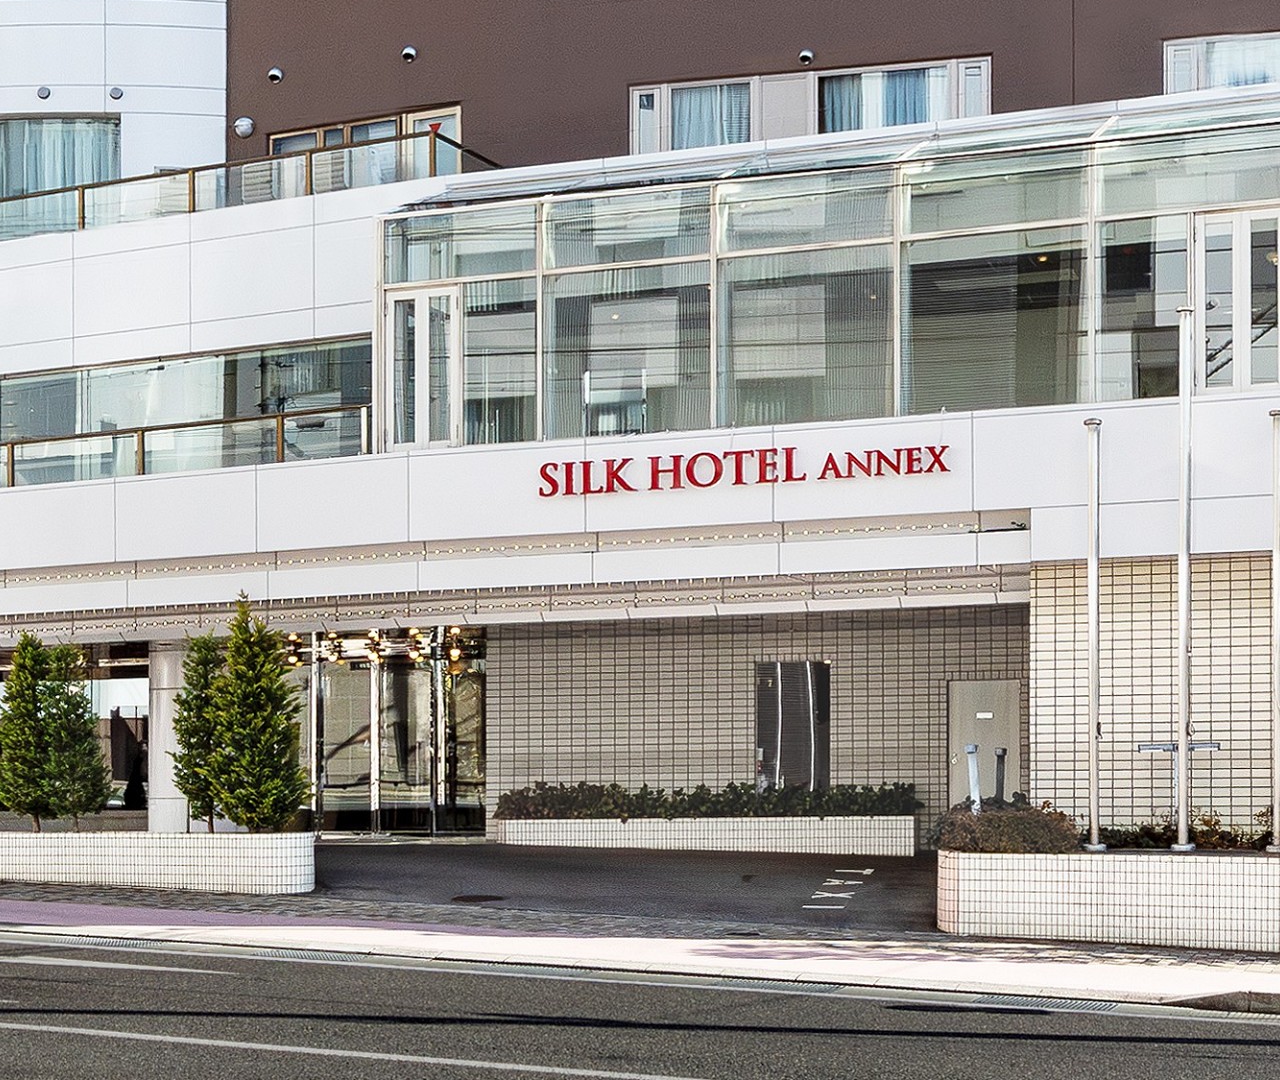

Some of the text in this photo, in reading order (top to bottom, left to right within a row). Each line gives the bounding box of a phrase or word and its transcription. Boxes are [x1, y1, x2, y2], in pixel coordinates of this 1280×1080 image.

[538, 445, 951, 497] SILK HOTEL ANNEX
[801, 868, 875, 910] TAXI
